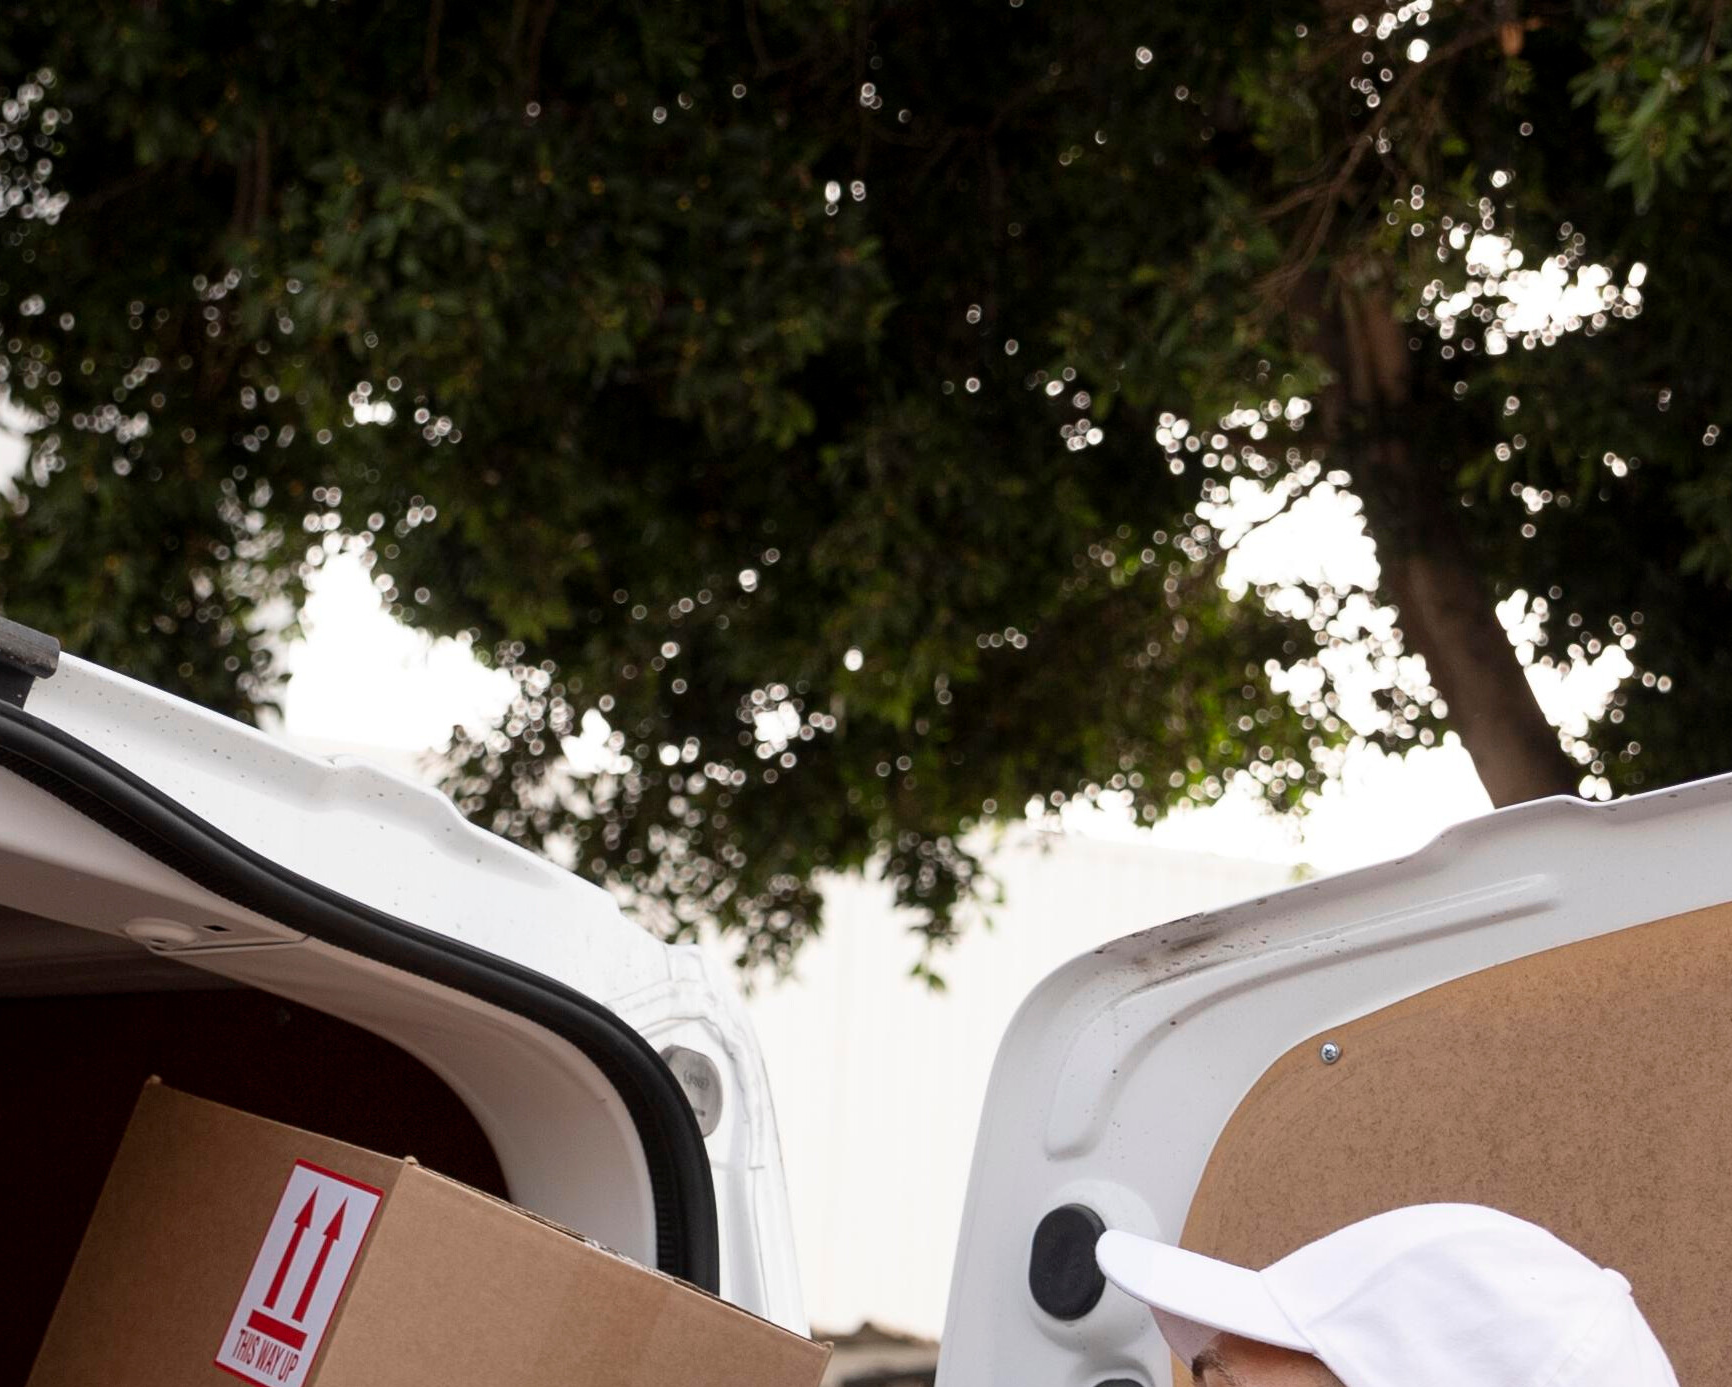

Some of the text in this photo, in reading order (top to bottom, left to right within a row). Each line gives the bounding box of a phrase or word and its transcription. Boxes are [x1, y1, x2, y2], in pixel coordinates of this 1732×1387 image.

[232, 1328, 299, 1383] THIS WAY UP
